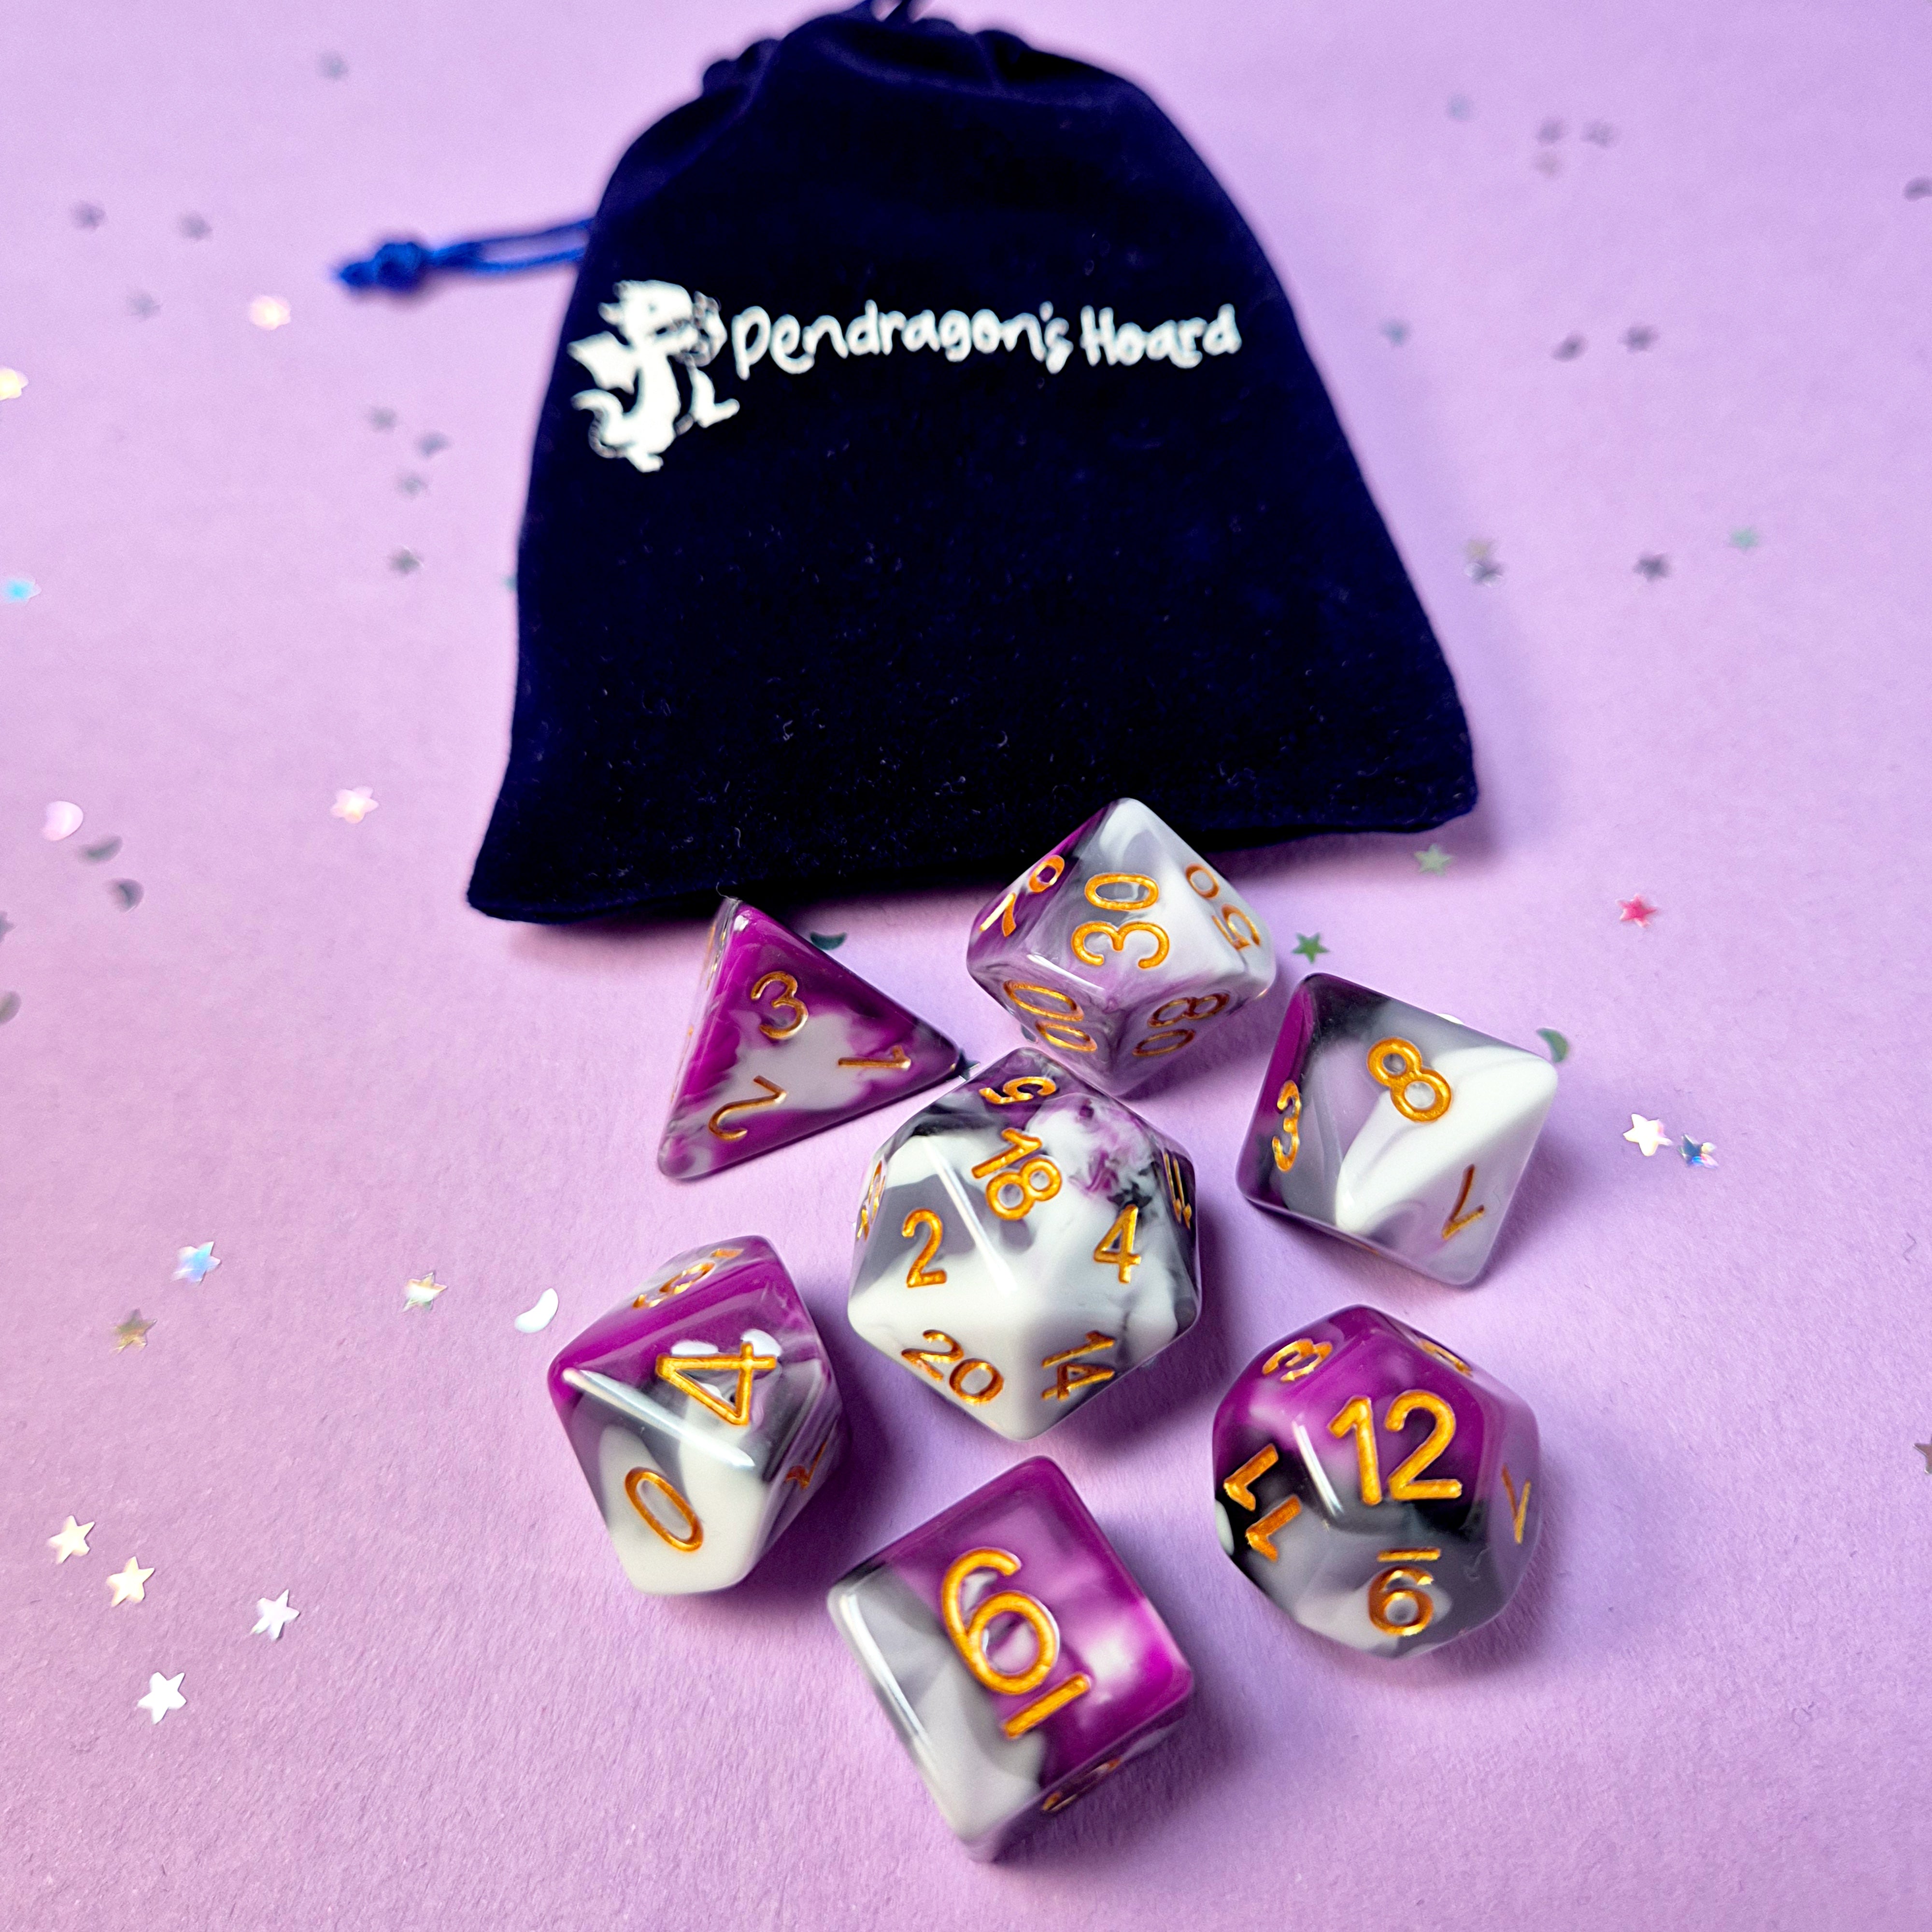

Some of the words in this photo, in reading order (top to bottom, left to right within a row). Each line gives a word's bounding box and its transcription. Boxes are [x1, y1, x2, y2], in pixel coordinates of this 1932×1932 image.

[1080, 303, 1242, 369] Hoard
[1071, 872, 1169, 969] 30
[1185, 863, 1261, 951] 50
[751, 971, 809, 1040] 3
[1132, 993, 1230, 1057] 80
[838, 1045, 912, 1070] 1
[1366, 1037, 1451, 1123] 8
[708, 1075, 787, 1141] 2
[1271, 1080, 1302, 1173] 3
[972, 1127, 1062, 1221] 18
[901, 1208, 947, 1289] 2
[1093, 1204, 1142, 1284] 4
[655, 1341, 777, 1426] 4
[901, 1329, 1004, 1405] 20
[1041, 1331, 1115, 1401] 14
[1327, 1390, 1463, 1506] 12
[624, 1466, 704, 1552] 0
[941, 1547, 1091, 1740] 6
